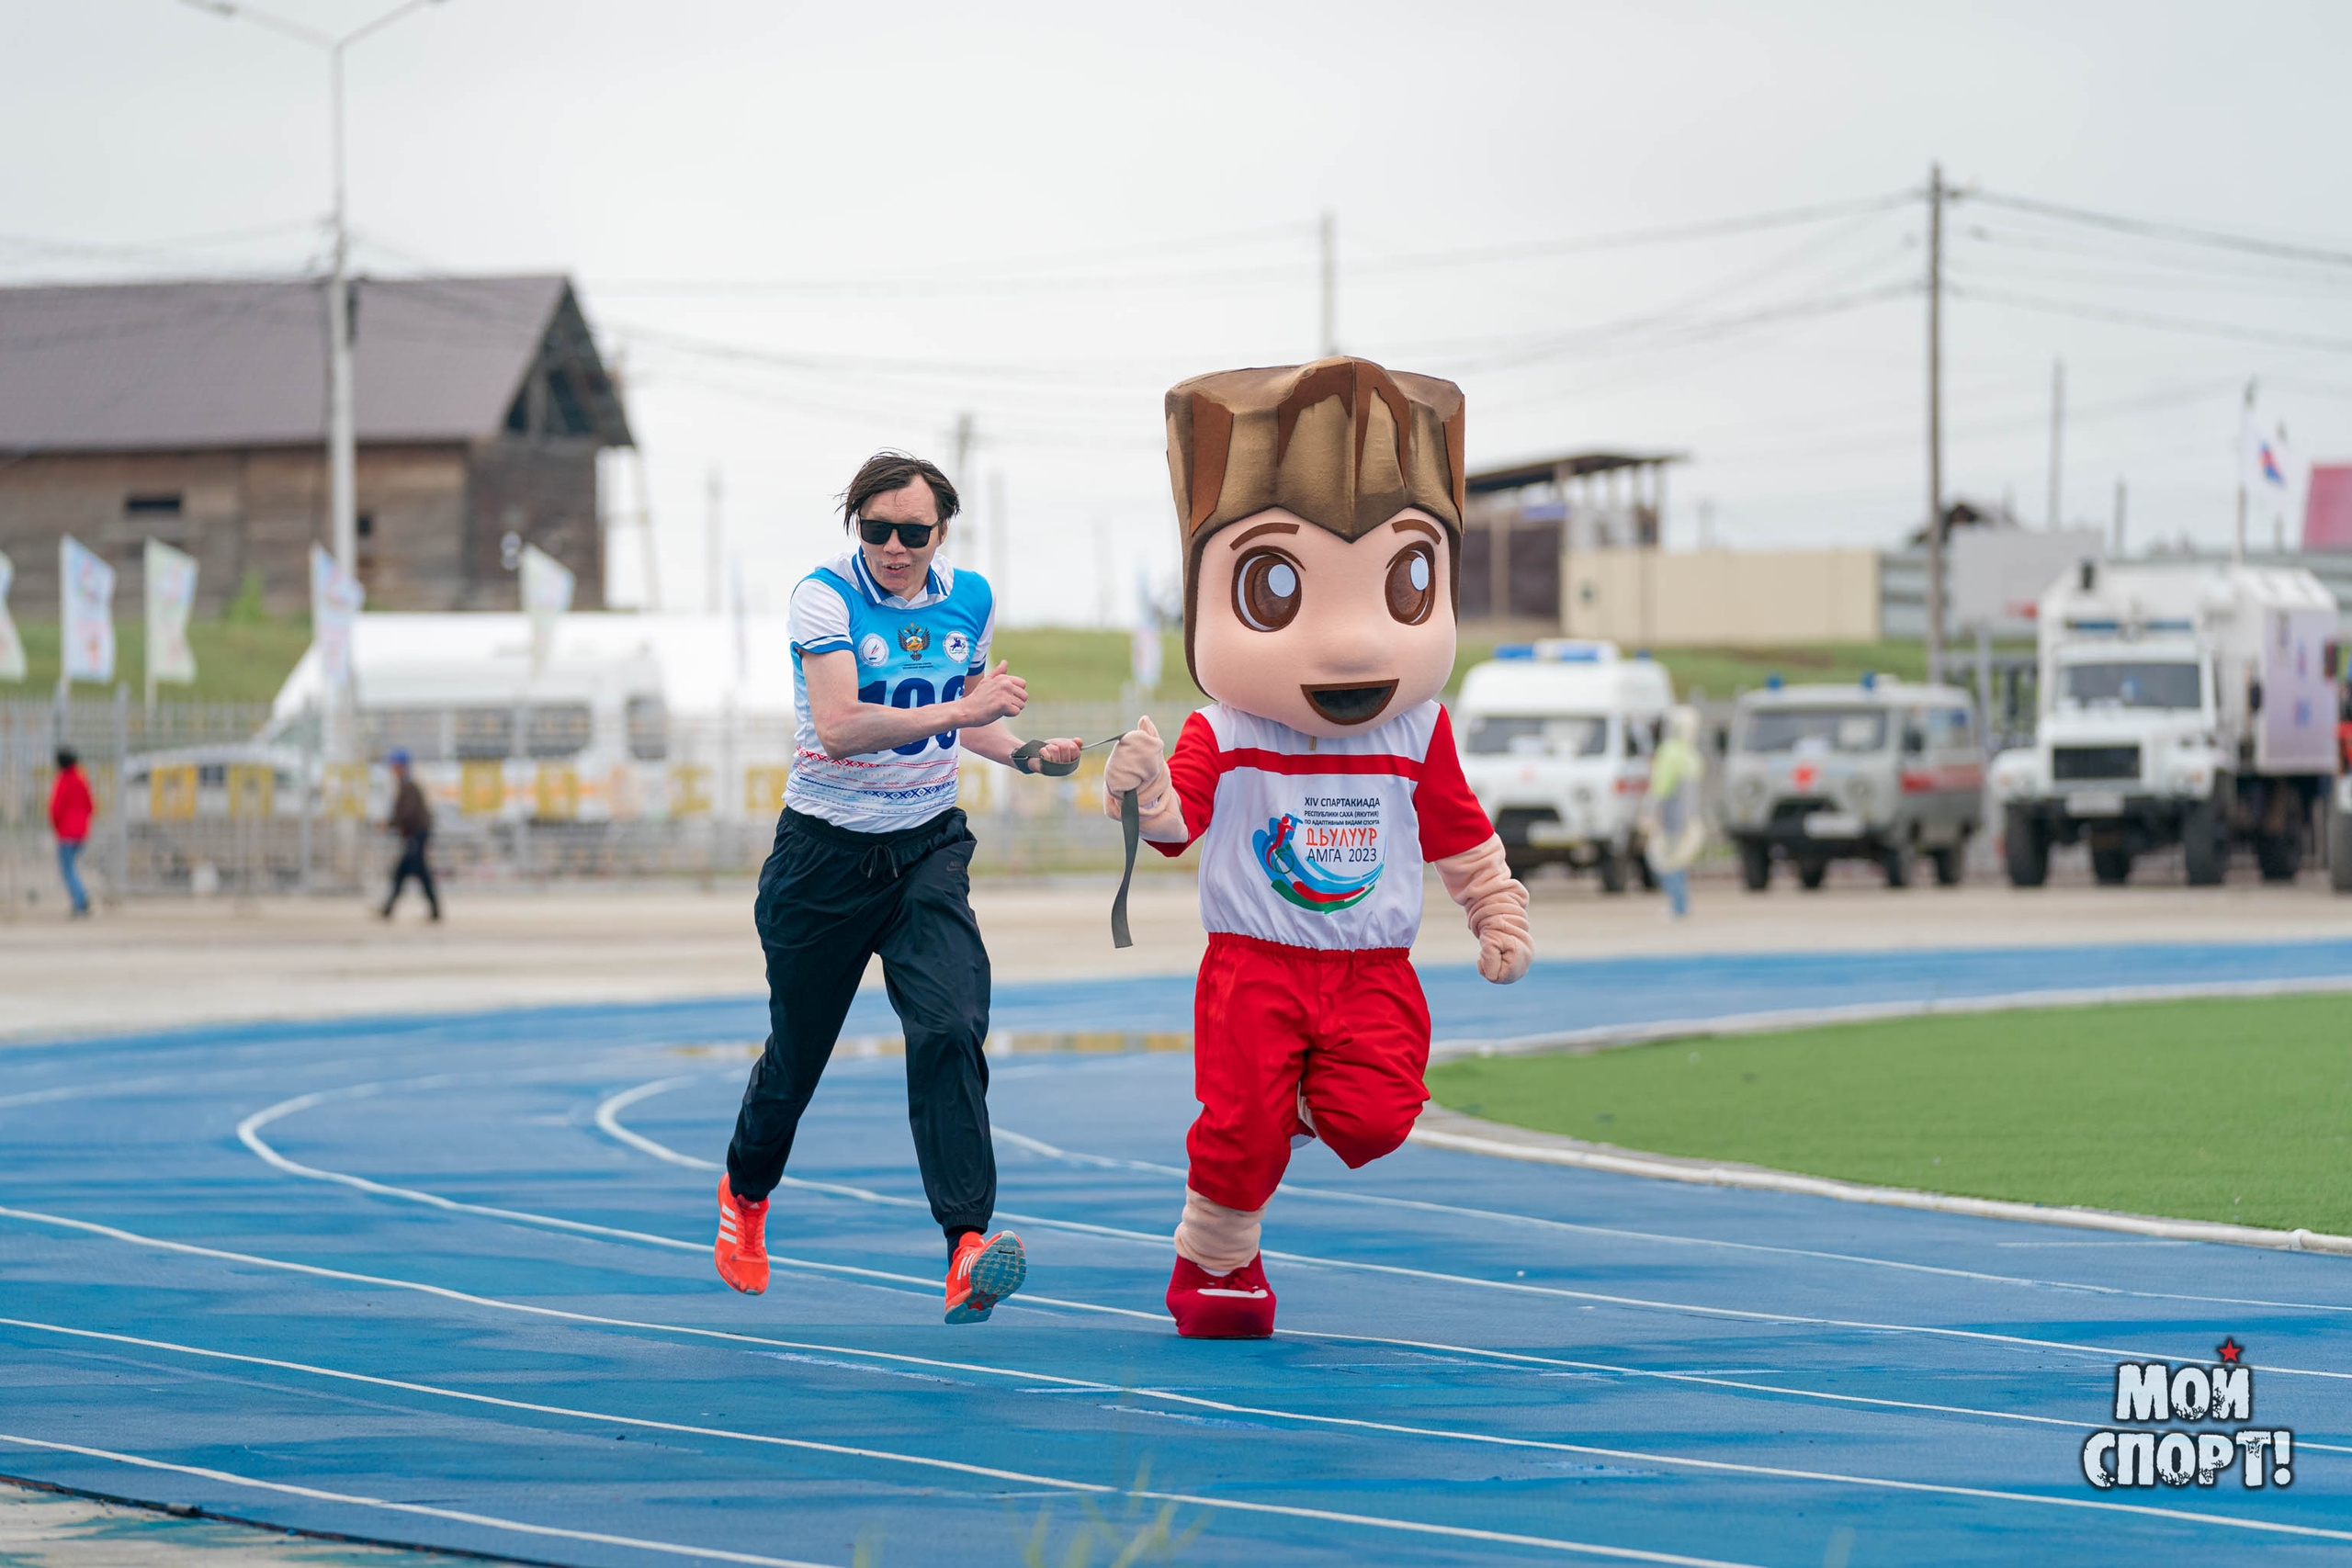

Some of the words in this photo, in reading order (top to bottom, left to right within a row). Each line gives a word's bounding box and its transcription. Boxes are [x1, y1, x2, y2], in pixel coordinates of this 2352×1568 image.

[1305, 797, 1318, 807] XIV
[1320, 797, 1380, 808] СПАРТАКИАДА
[1306, 827, 1377, 847] ДЬУЛУУР
[1306, 848, 1342, 863] АМГА
[1349, 848, 1377, 863] 2023
